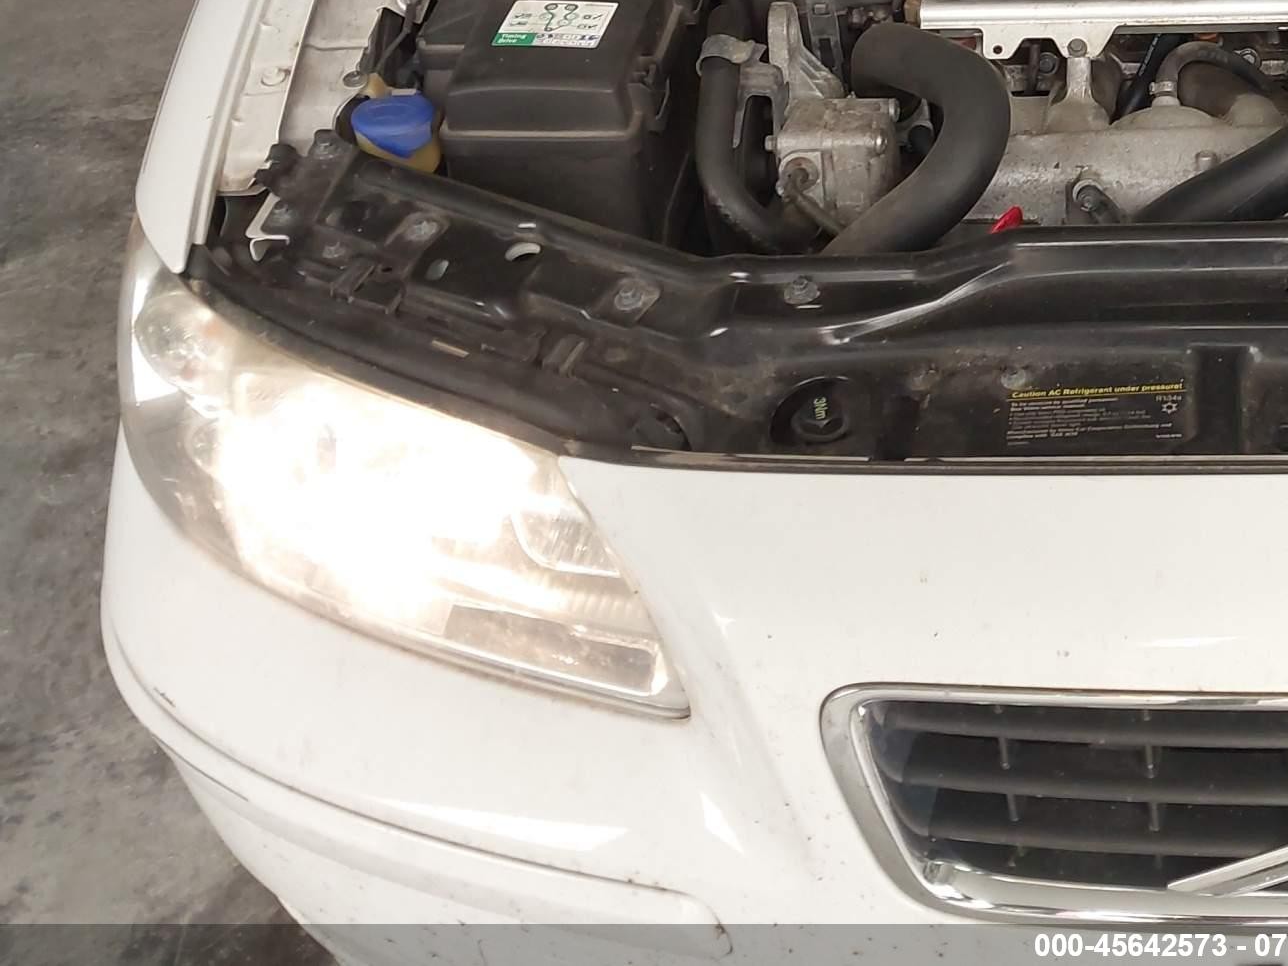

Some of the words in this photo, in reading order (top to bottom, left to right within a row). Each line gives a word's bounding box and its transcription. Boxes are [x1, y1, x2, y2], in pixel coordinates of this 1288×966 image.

[1012, 390, 1047, 398] Caution
[1048, 388, 1061, 396] AC
[1062, 385, 1113, 396] Refrigerant
[1113, 384, 1139, 393] under
